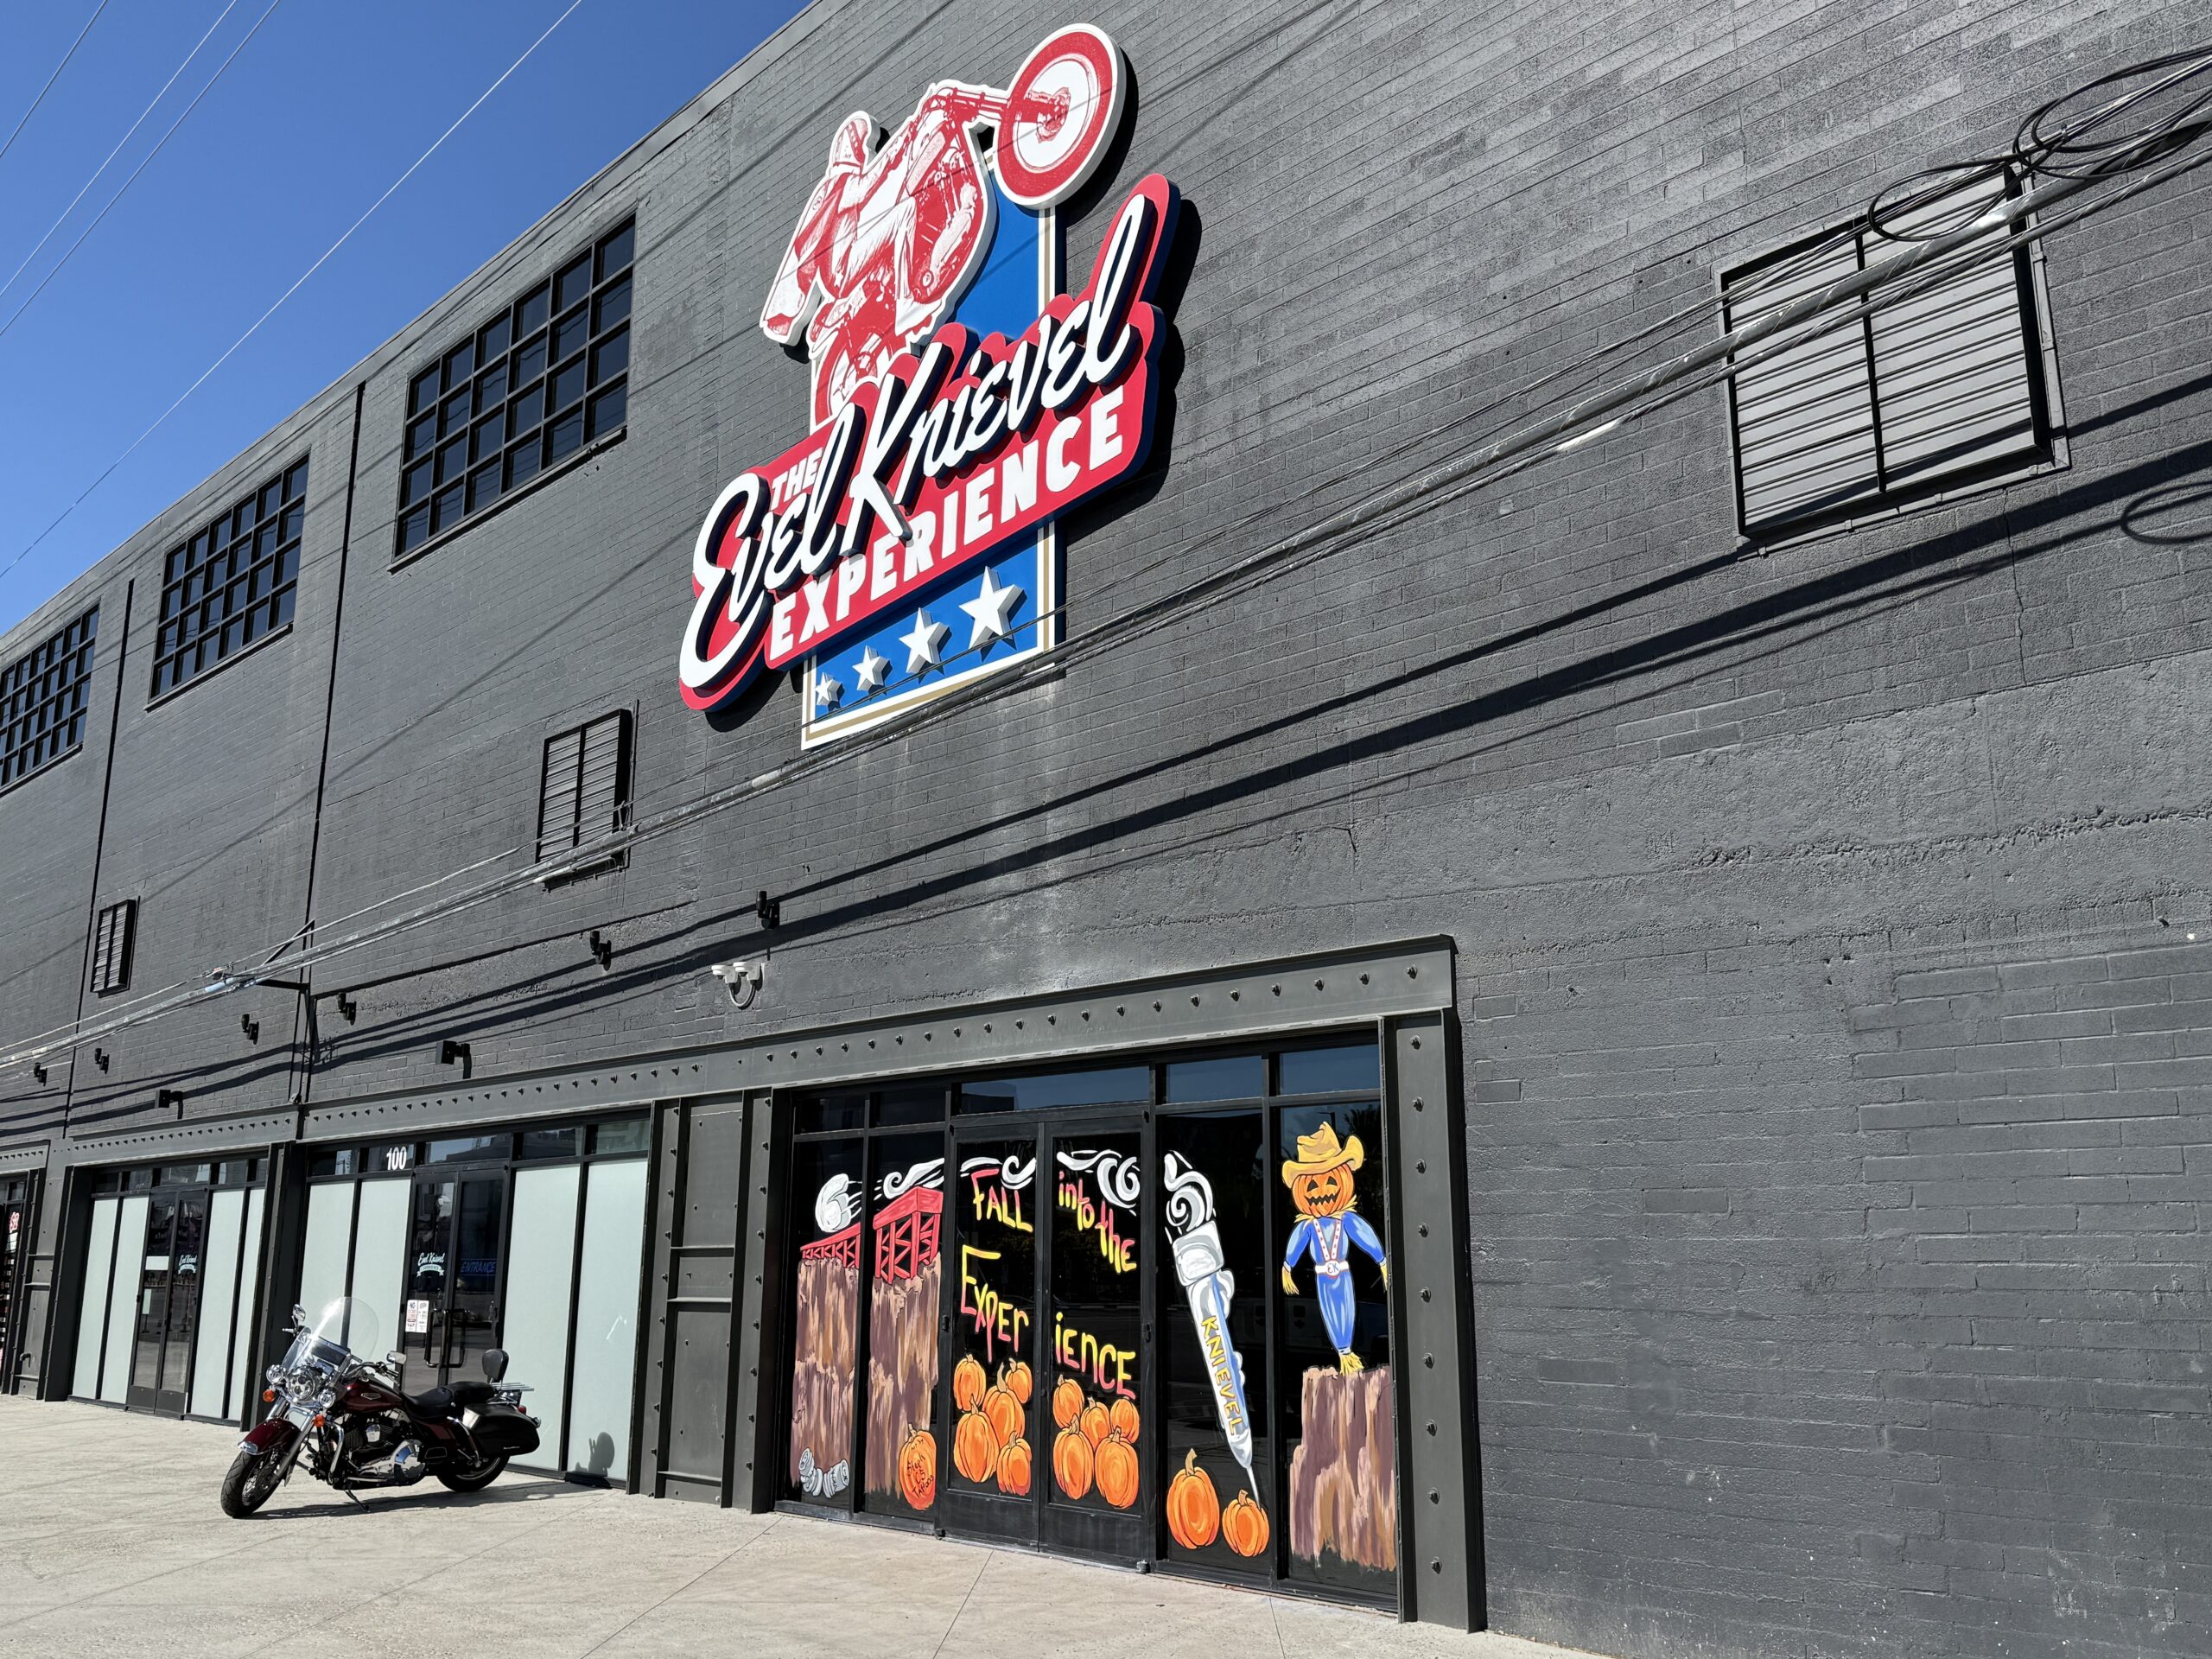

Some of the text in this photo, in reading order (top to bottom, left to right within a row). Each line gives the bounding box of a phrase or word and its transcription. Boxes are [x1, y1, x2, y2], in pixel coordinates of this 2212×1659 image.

[679, 194, 1146, 689] Evel Knievel
[769, 446, 824, 512] THE
[769, 385, 1124, 662] EXPERIENCE
[386, 1146, 407, 1171] 100
[970, 1167, 1033, 1232] FALL
[1058, 1170, 1096, 1231] into
[461, 1261, 497, 1274] ENTRANCE
[1200, 1314, 1244, 1436] KNIEVEL
